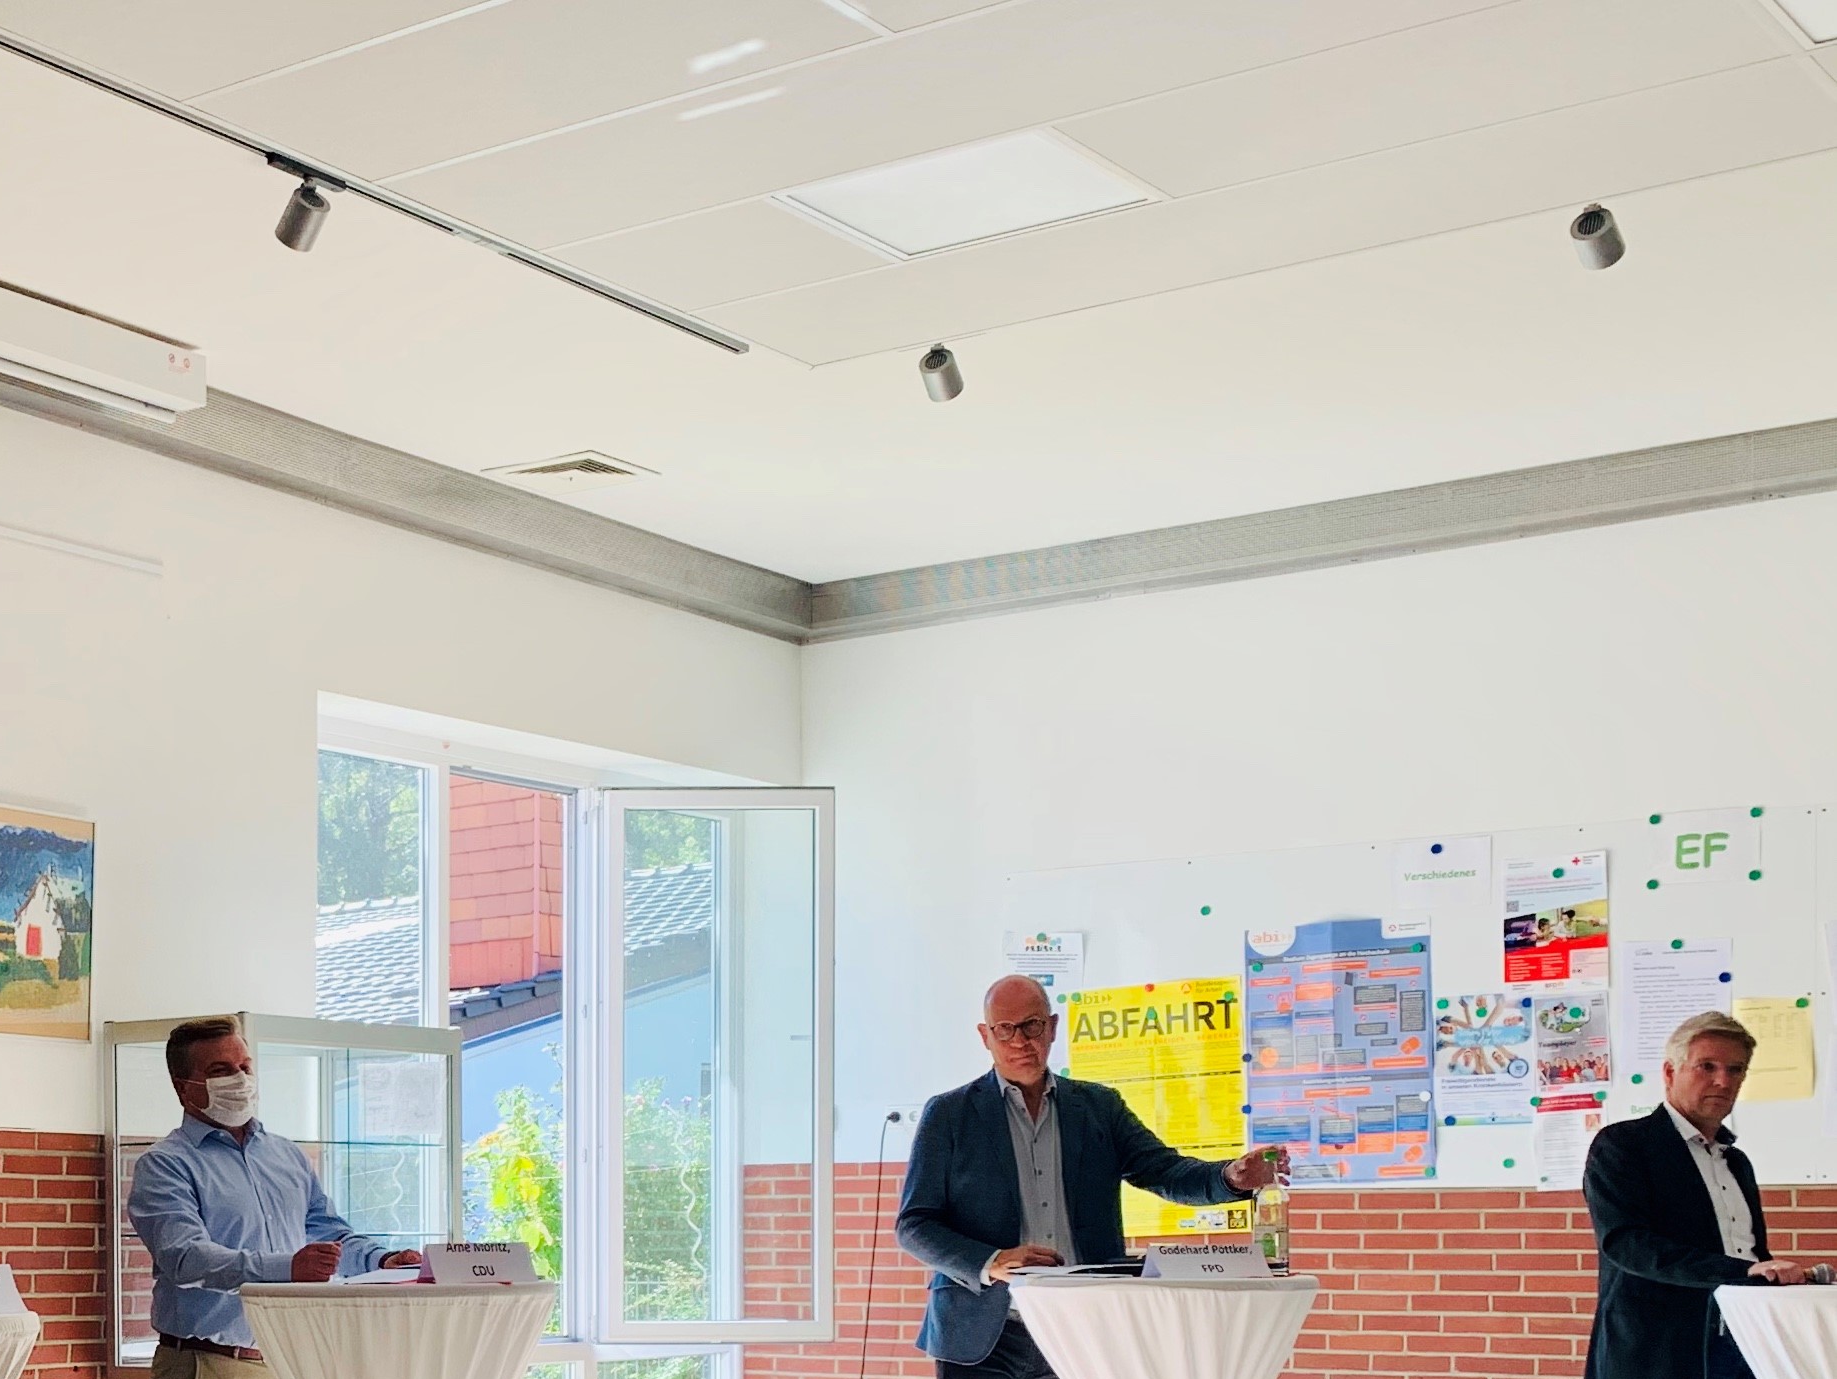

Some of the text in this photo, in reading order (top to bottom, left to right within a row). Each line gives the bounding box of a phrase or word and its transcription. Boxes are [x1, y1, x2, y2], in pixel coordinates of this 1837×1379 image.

[1675, 832, 1729, 869] EF
[1404, 868, 1477, 882] Verschiedenes
[1072, 998, 1238, 1043] ABFAHRT
[446, 1243, 471, 1253] Arne
[1158, 1245, 1210, 1255] Godehard
[472, 1265, 495, 1276] CDU
